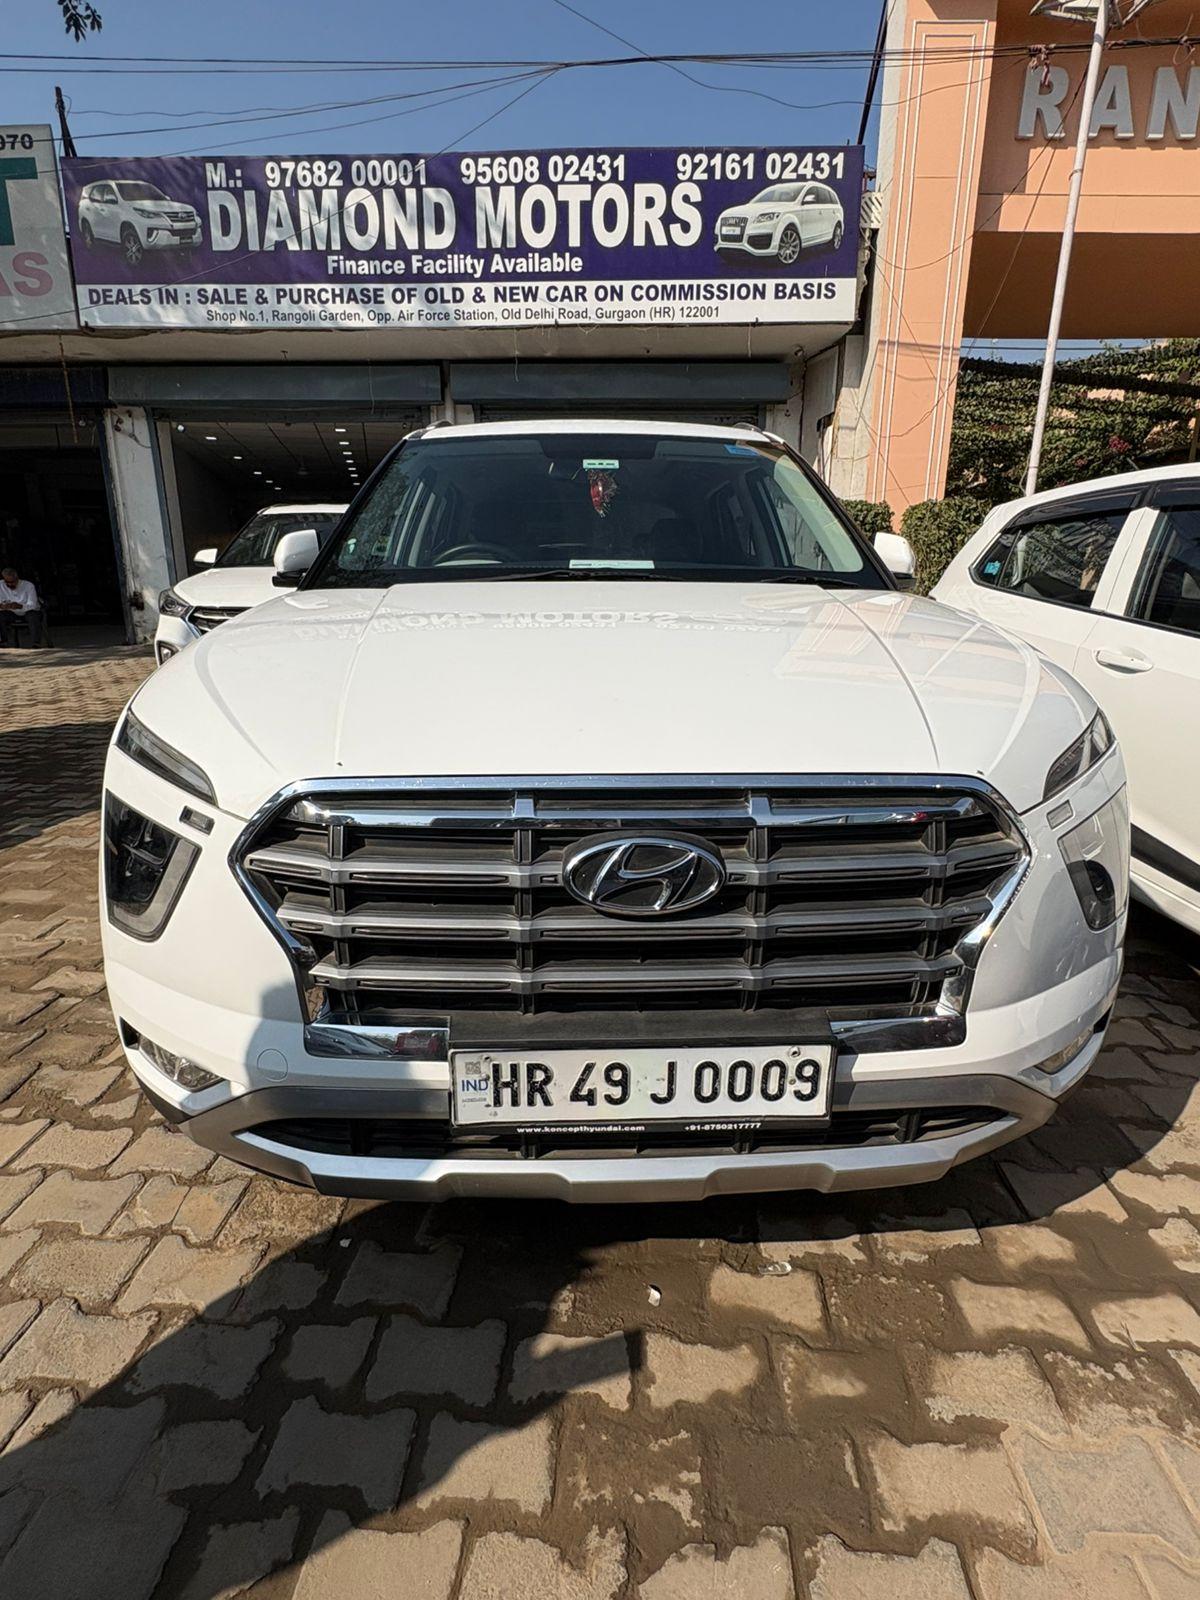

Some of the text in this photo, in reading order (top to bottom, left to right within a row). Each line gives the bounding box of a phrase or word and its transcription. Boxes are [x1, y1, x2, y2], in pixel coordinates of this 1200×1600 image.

[265, 160, 343, 188] 97682
[351, 158, 427, 187] 00001
[460, 156, 540, 185] 95608
[548, 154, 626, 183] 02431
[676, 153, 755, 181] 92161
[765, 152, 845, 180] 02431
[206, 181, 703, 252] DIAMOND MOTORS
[327, 252, 583, 279] Finance Facility Available
[88, 288, 152, 305] DEALS
[158, 288, 179, 305] IN
[197, 288, 248, 305] SALE
[254, 288, 269, 305] &
[275, 287, 386, 305] PURCHASE
[391, 287, 418, 304] OF
[424, 286, 465, 304] OLD
[472, 286, 486, 303] &
[494, 285, 540, 303] NEW
[545, 285, 588, 303] CAR
[594, 284, 624, 302] ON
[631, 283, 767, 302] COMMISSION
[774, 282, 837, 301] BASIS
[206, 305, 720, 325] Shop No.1, Rangoli Garden, Opp. Air Force Station, Old Delhi Road, Gurgaon (HR) 122001
[461, 1079, 489, 1092] IND
[491, 1058, 822, 1108] HR 49 J 0009
